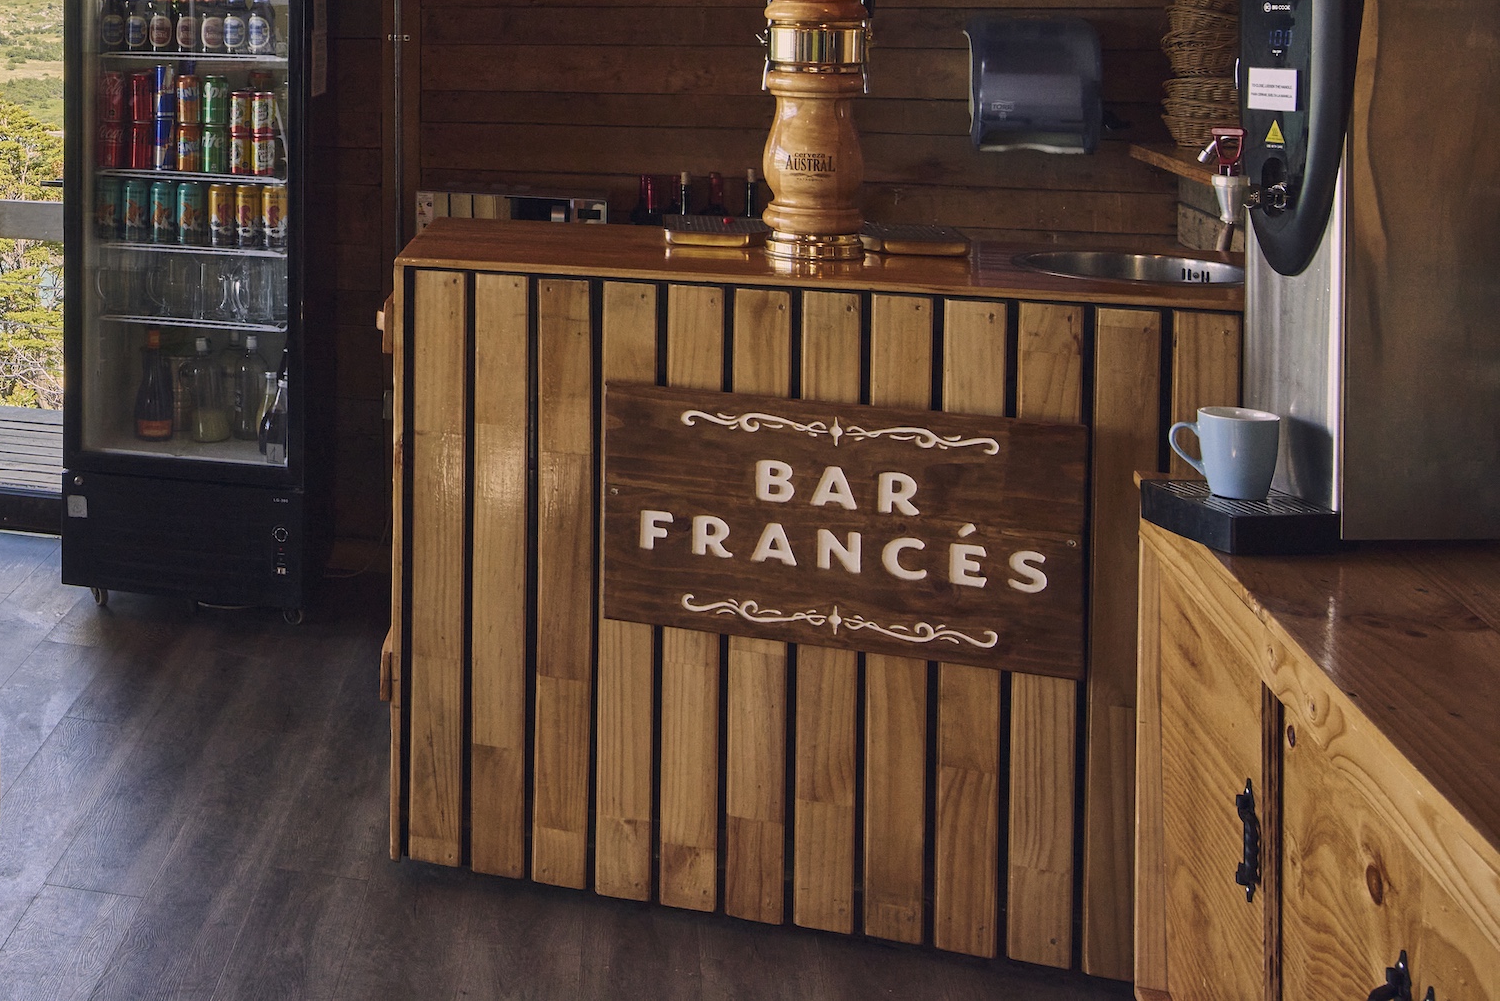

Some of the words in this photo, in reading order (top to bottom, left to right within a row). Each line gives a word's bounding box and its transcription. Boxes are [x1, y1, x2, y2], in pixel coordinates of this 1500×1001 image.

[1269, 29, 1293, 47] 100
[785, 154, 836, 172] AUSTRAL
[753, 458, 921, 517] BAR
[638, 509, 1049, 595] FRANCÉS
